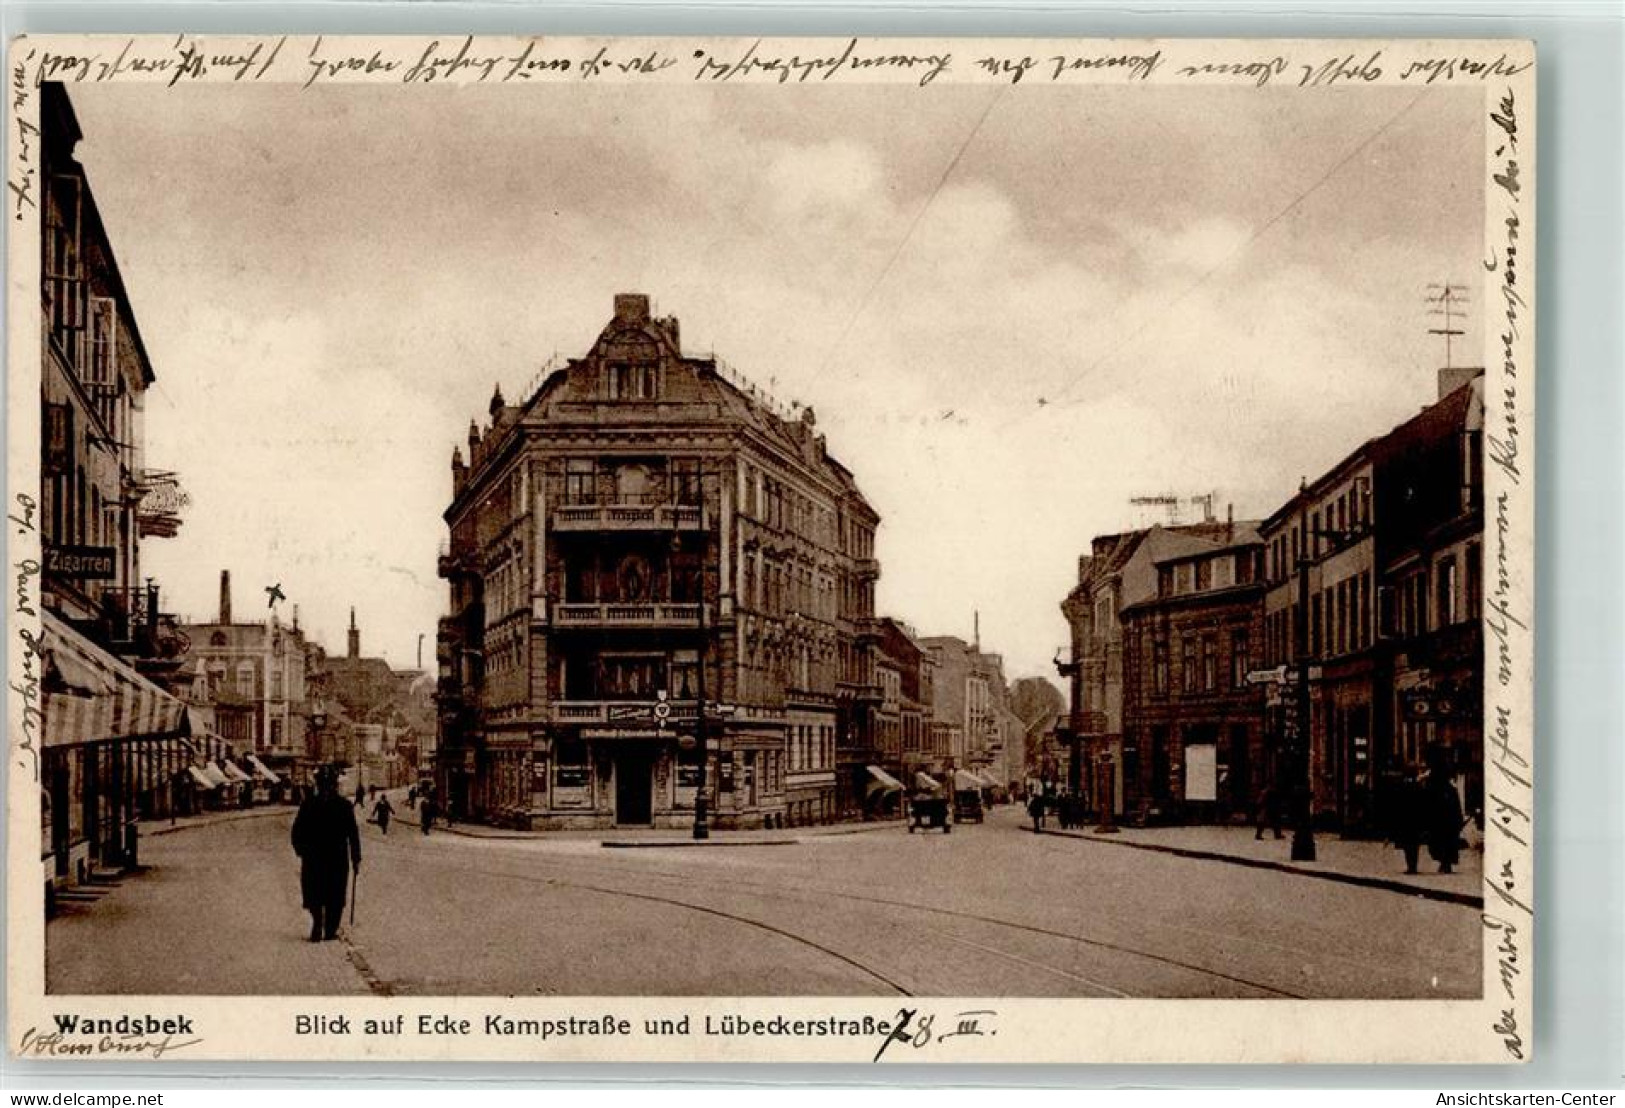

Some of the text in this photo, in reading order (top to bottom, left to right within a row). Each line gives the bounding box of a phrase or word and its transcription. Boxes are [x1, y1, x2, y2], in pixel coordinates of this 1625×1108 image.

[49, 549, 112, 574] Zigarren
[54, 1015, 192, 1034] Wandsbek
[296, 1013, 890, 1040] Blick auf Ecke Kampstraße und Lübeckerstraße
